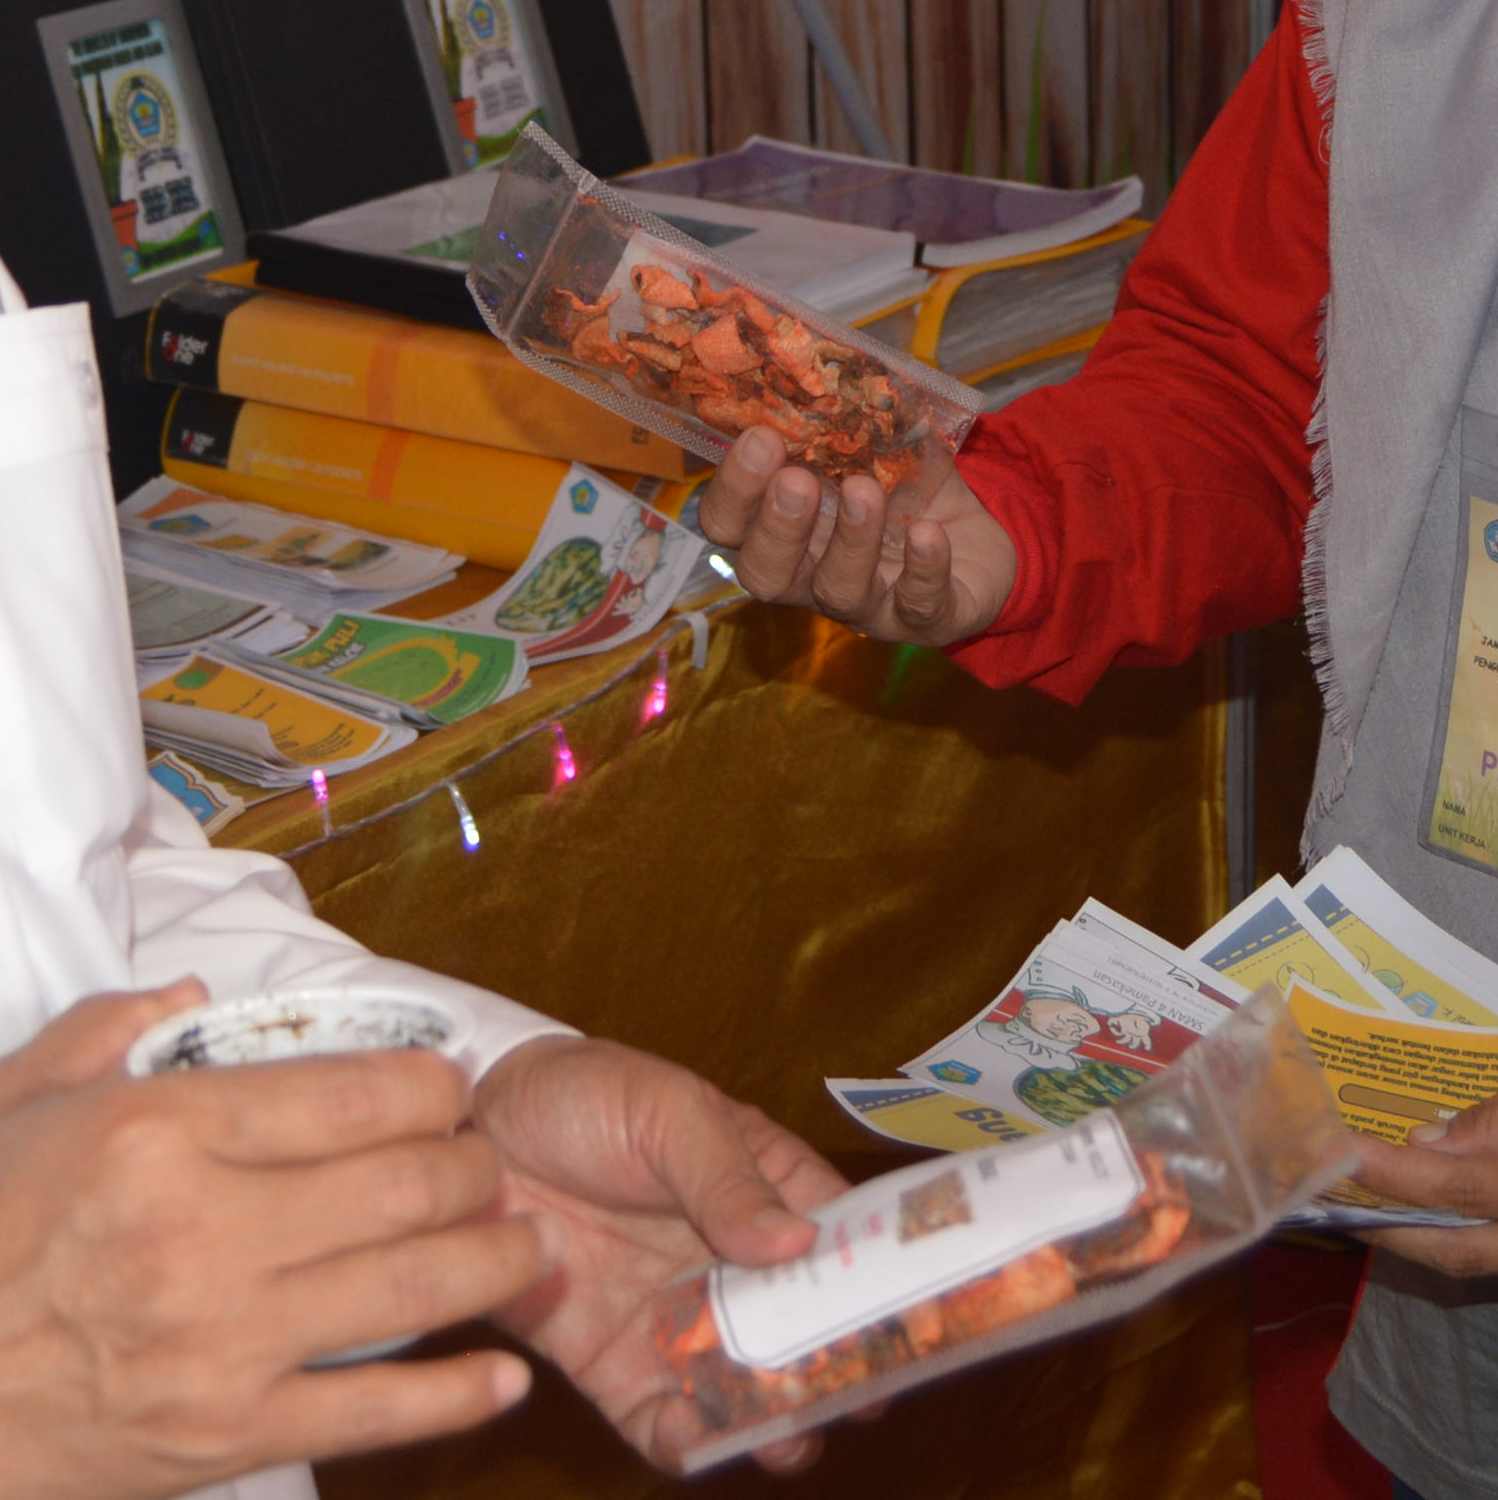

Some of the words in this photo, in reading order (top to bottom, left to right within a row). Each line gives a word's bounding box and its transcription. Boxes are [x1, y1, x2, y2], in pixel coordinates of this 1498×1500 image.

[1443, 800, 1466, 816] NAMA
[1438, 823, 1458, 838] UNIT
[1459, 828, 1486, 849] KERJA
[1093, 970, 1157, 1008] Pamekasan
[1168, 1007, 1205, 1031] SMAN
